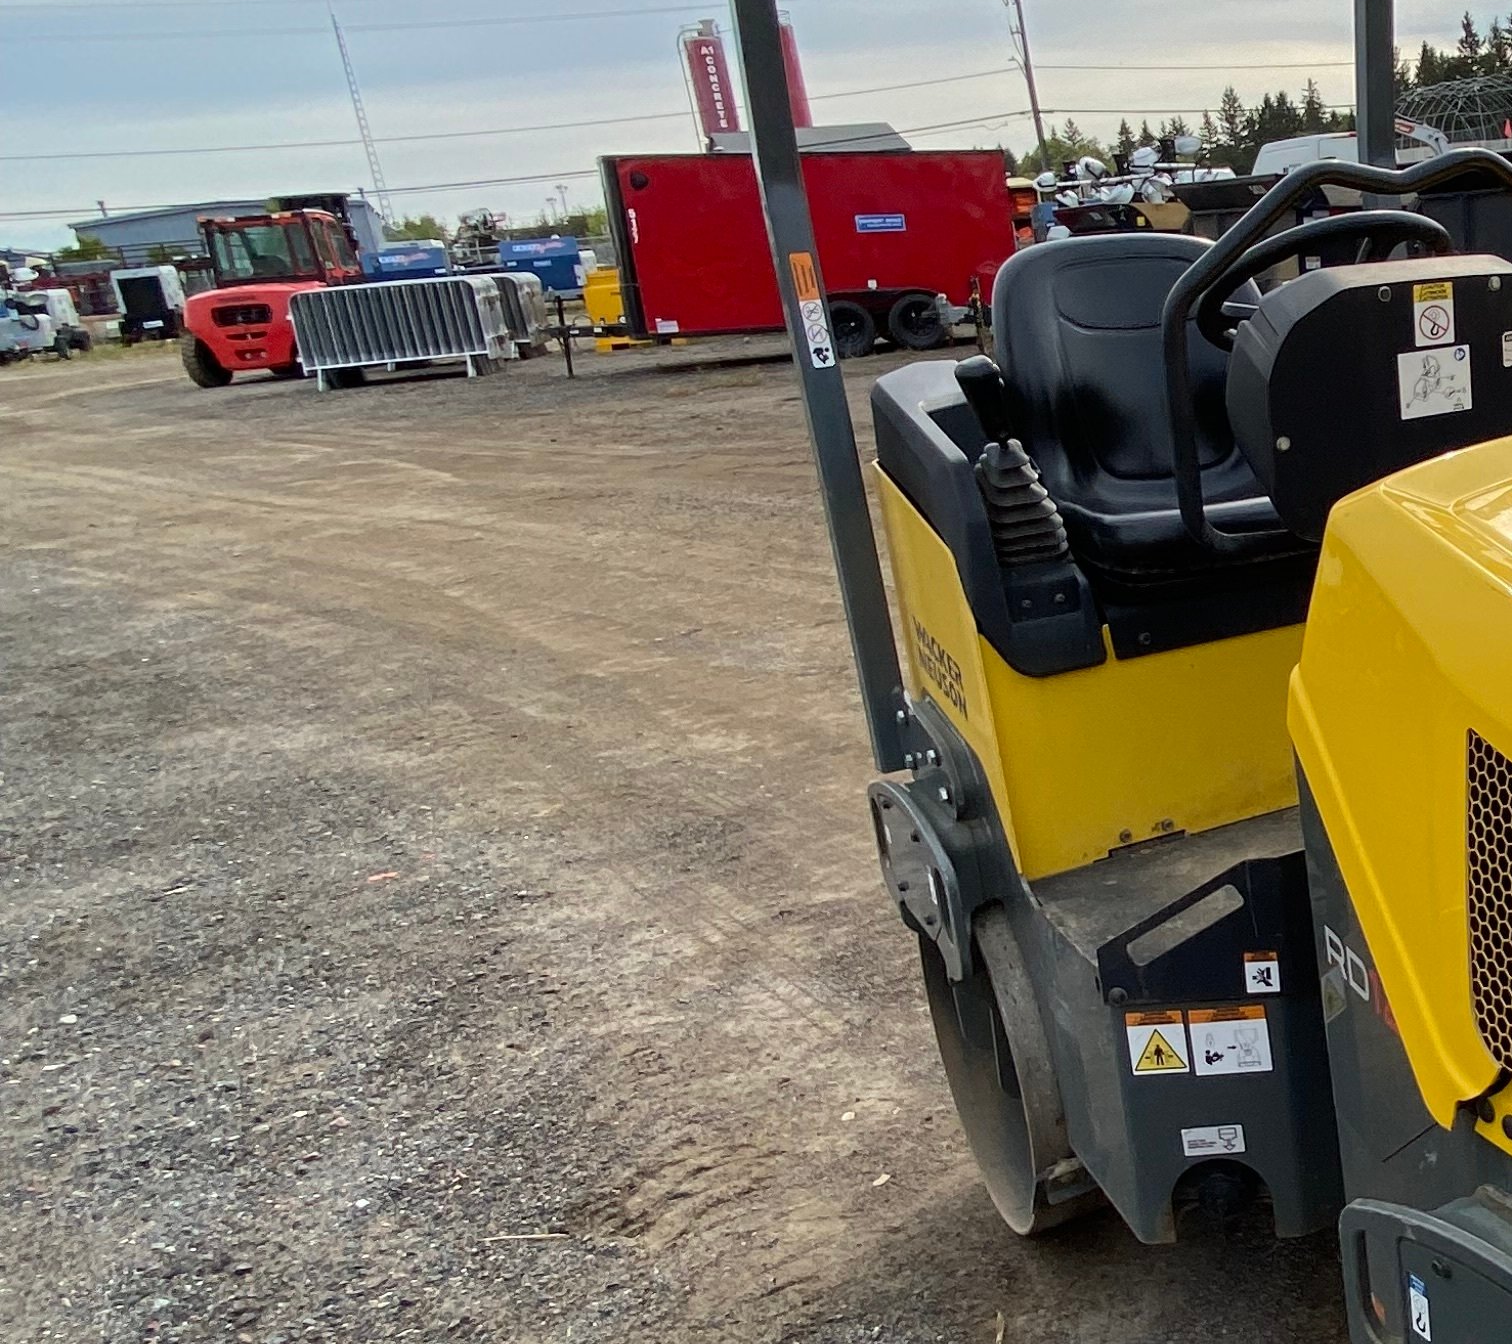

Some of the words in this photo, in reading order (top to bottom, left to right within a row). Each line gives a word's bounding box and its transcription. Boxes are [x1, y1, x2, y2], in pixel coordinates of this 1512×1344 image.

[705, 56, 729, 129] CONCRETE
[912, 616, 964, 694] WACKER
[918, 643, 968, 721] NEUSON
